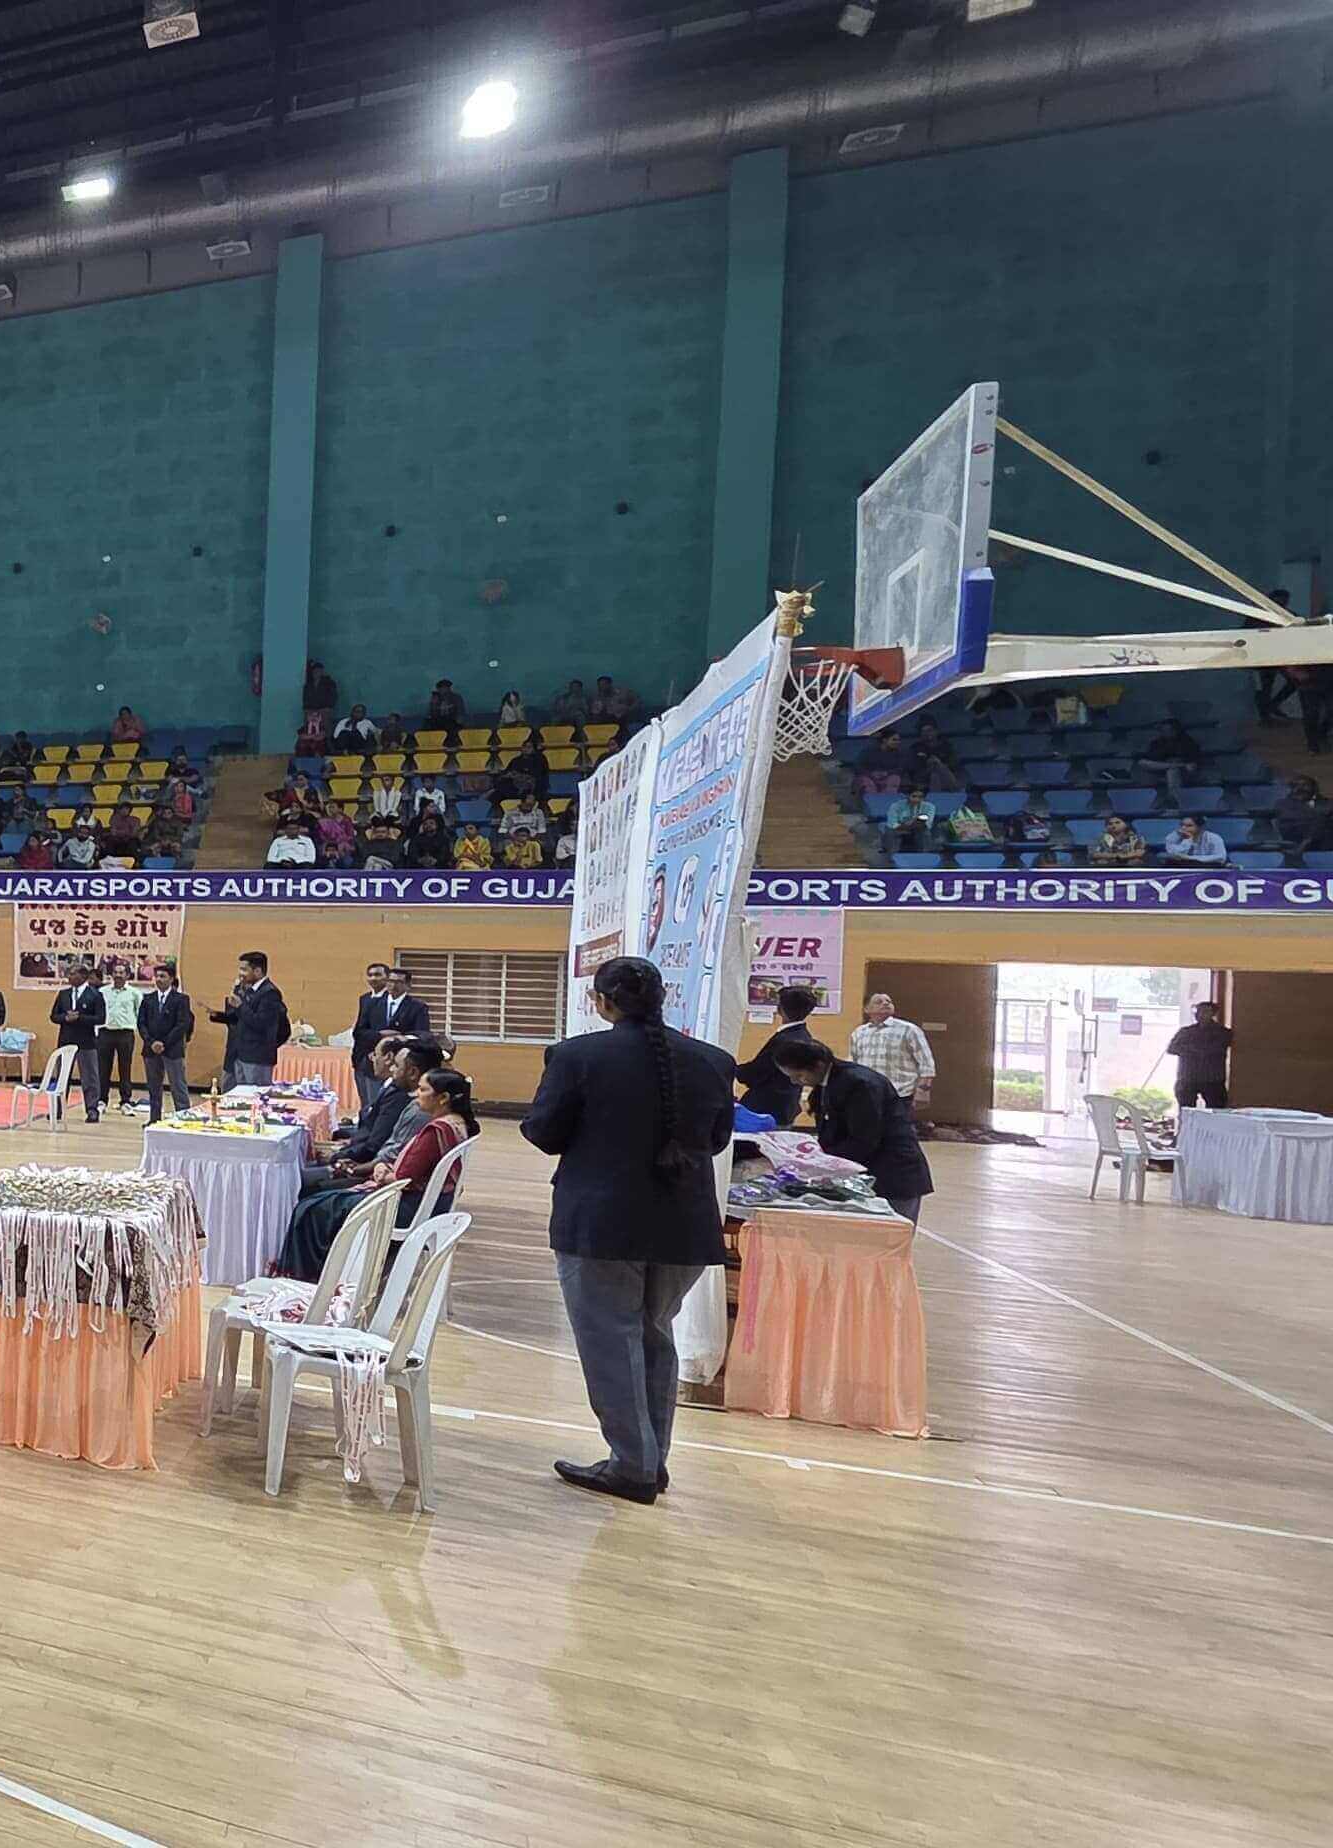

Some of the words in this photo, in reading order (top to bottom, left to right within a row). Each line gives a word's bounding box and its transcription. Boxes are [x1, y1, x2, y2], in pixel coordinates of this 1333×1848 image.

[219, 877, 412, 898] AUTHORITY
[421, 878, 471, 898] OF
[898, 879, 1183, 902] AUTHORITY
[1195, 879, 1266, 903] OF
[73, 912, 107, 937] કેક
